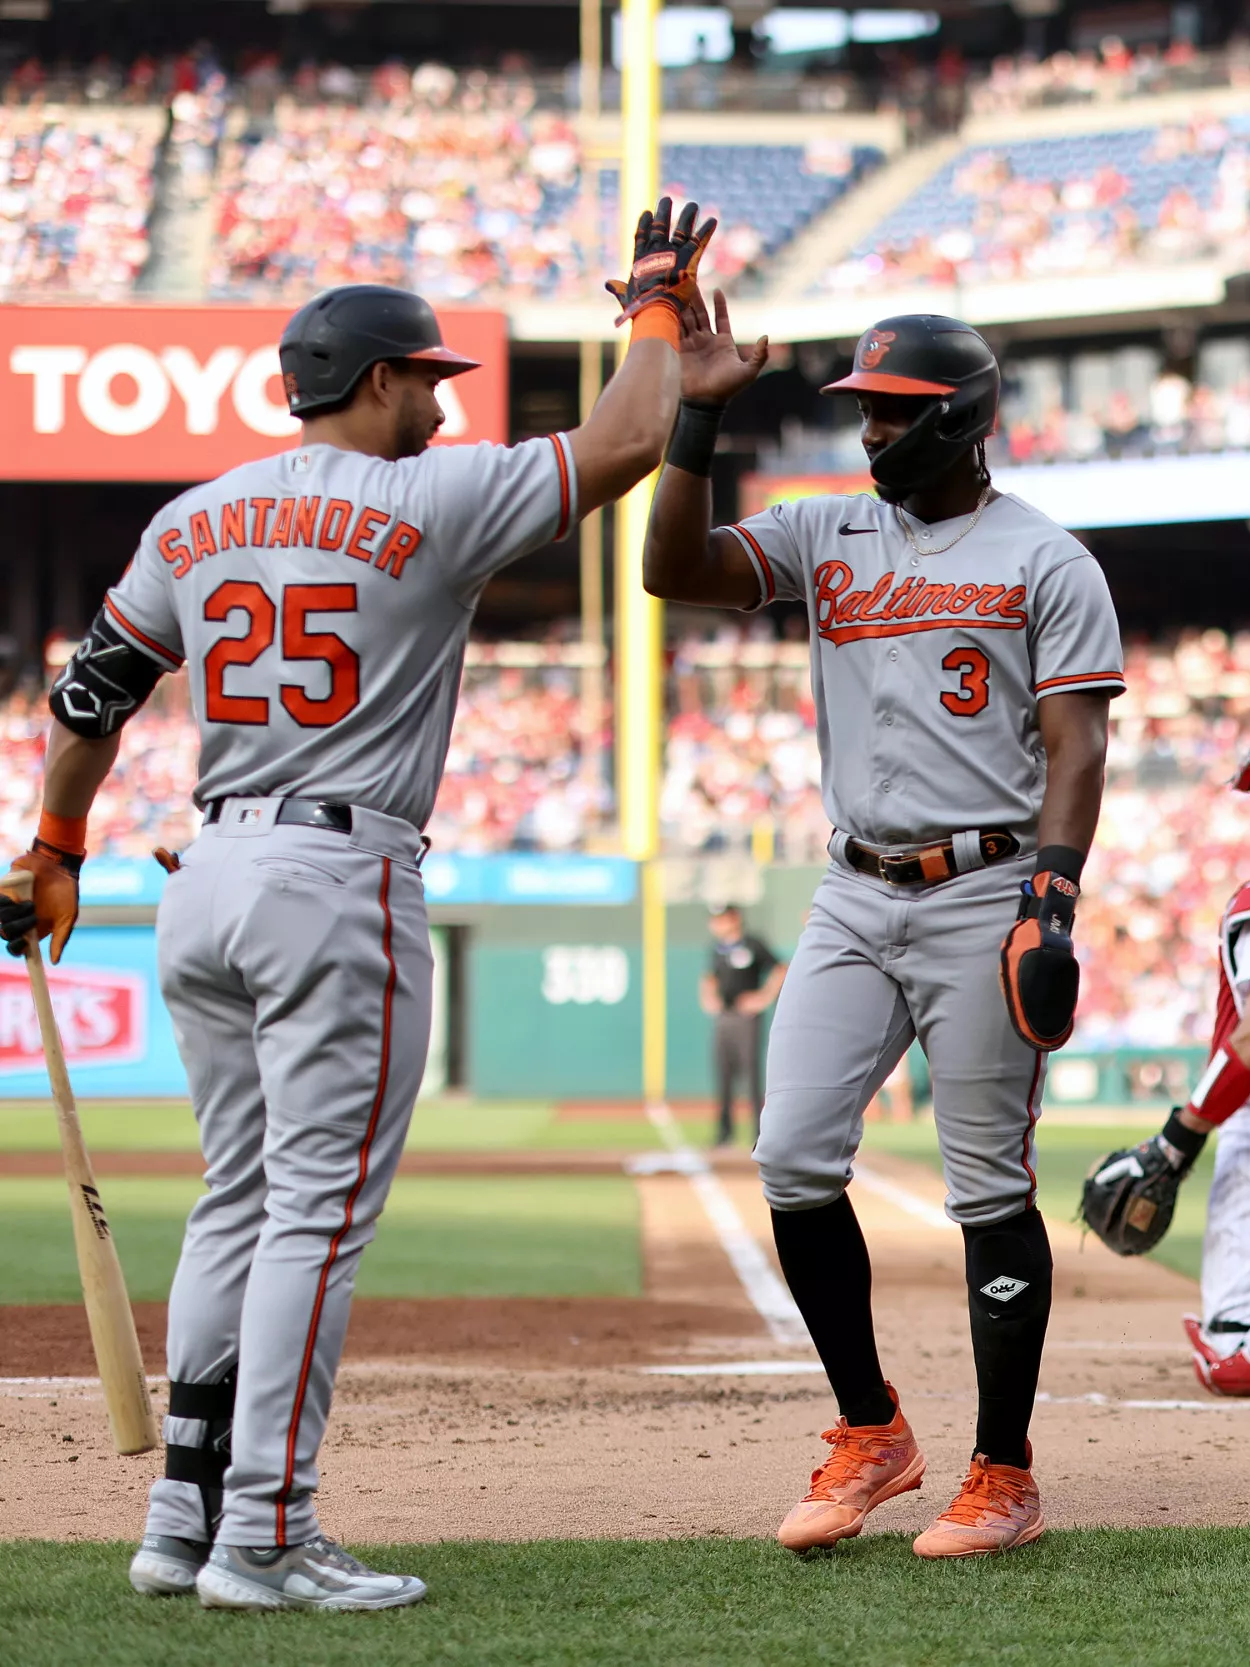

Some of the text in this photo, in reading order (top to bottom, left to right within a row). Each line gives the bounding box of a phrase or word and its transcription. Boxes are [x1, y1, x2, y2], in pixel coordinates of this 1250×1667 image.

[10, 342, 469, 437] TOYO
[157, 496, 423, 581] SANTANDER
[813, 559, 1029, 634] Baltimore
[203, 579, 361, 728] 25
[939, 646, 990, 717] 3
[985, 840, 998, 855] 3
[990, 1282, 1017, 1294] PRO
